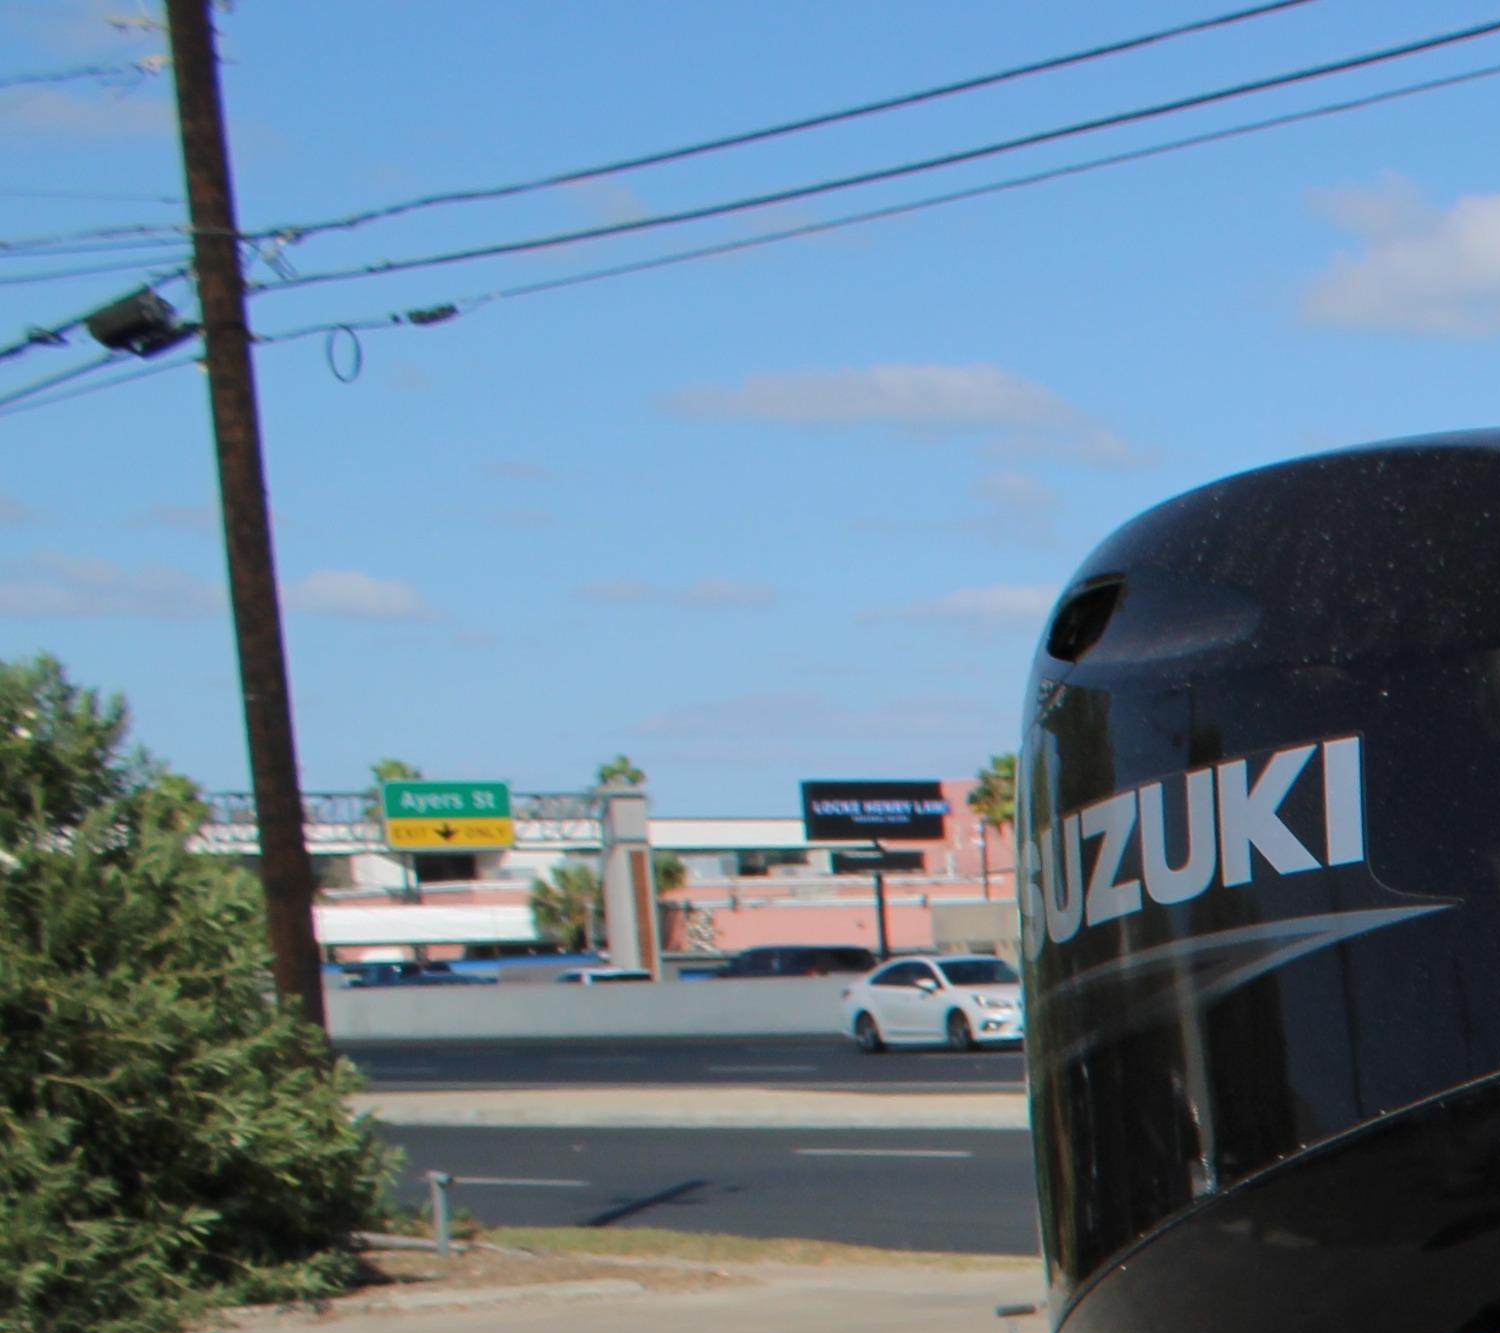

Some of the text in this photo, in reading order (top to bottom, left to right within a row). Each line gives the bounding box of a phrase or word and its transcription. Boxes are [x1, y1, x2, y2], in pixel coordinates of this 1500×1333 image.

[400, 790, 496, 814] Ayers St
[1020, 735, 1364, 962] SUZUKI
